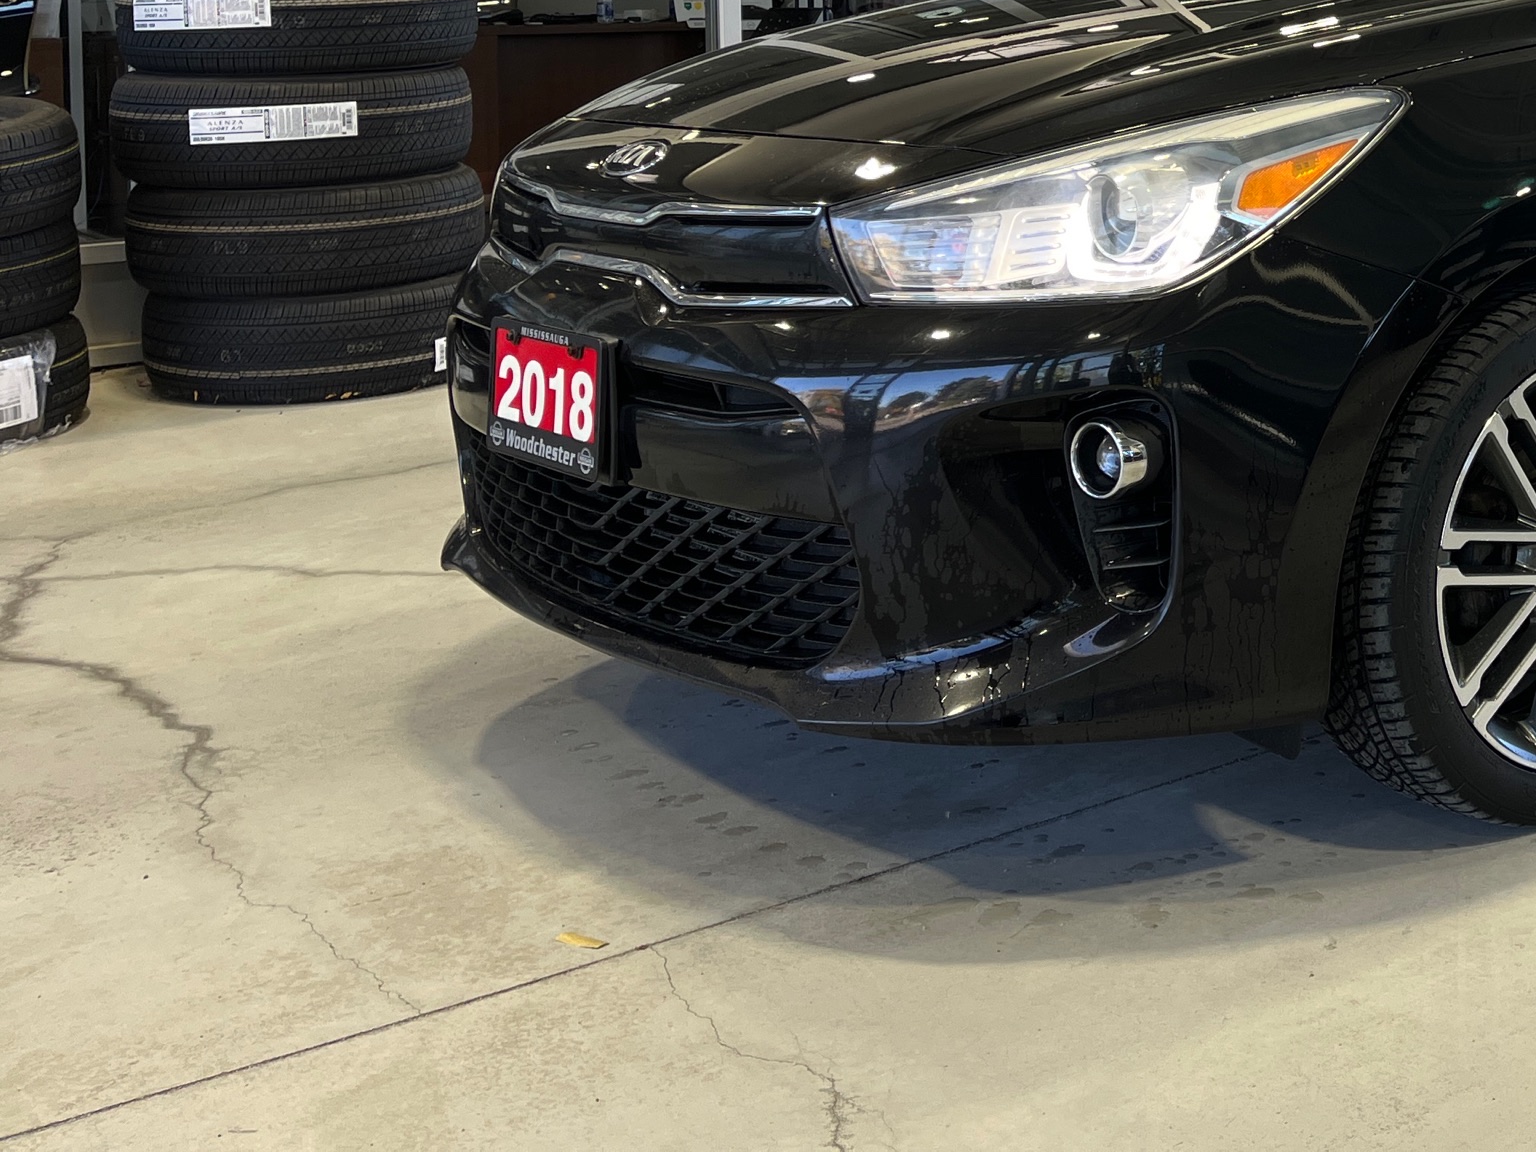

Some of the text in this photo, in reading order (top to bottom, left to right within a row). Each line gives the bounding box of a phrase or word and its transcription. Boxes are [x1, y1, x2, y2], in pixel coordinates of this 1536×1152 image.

[520, 326, 569, 346] MISSISSAUGA
[497, 354, 594, 443] 2018
[505, 428, 576, 467] Woodchester
